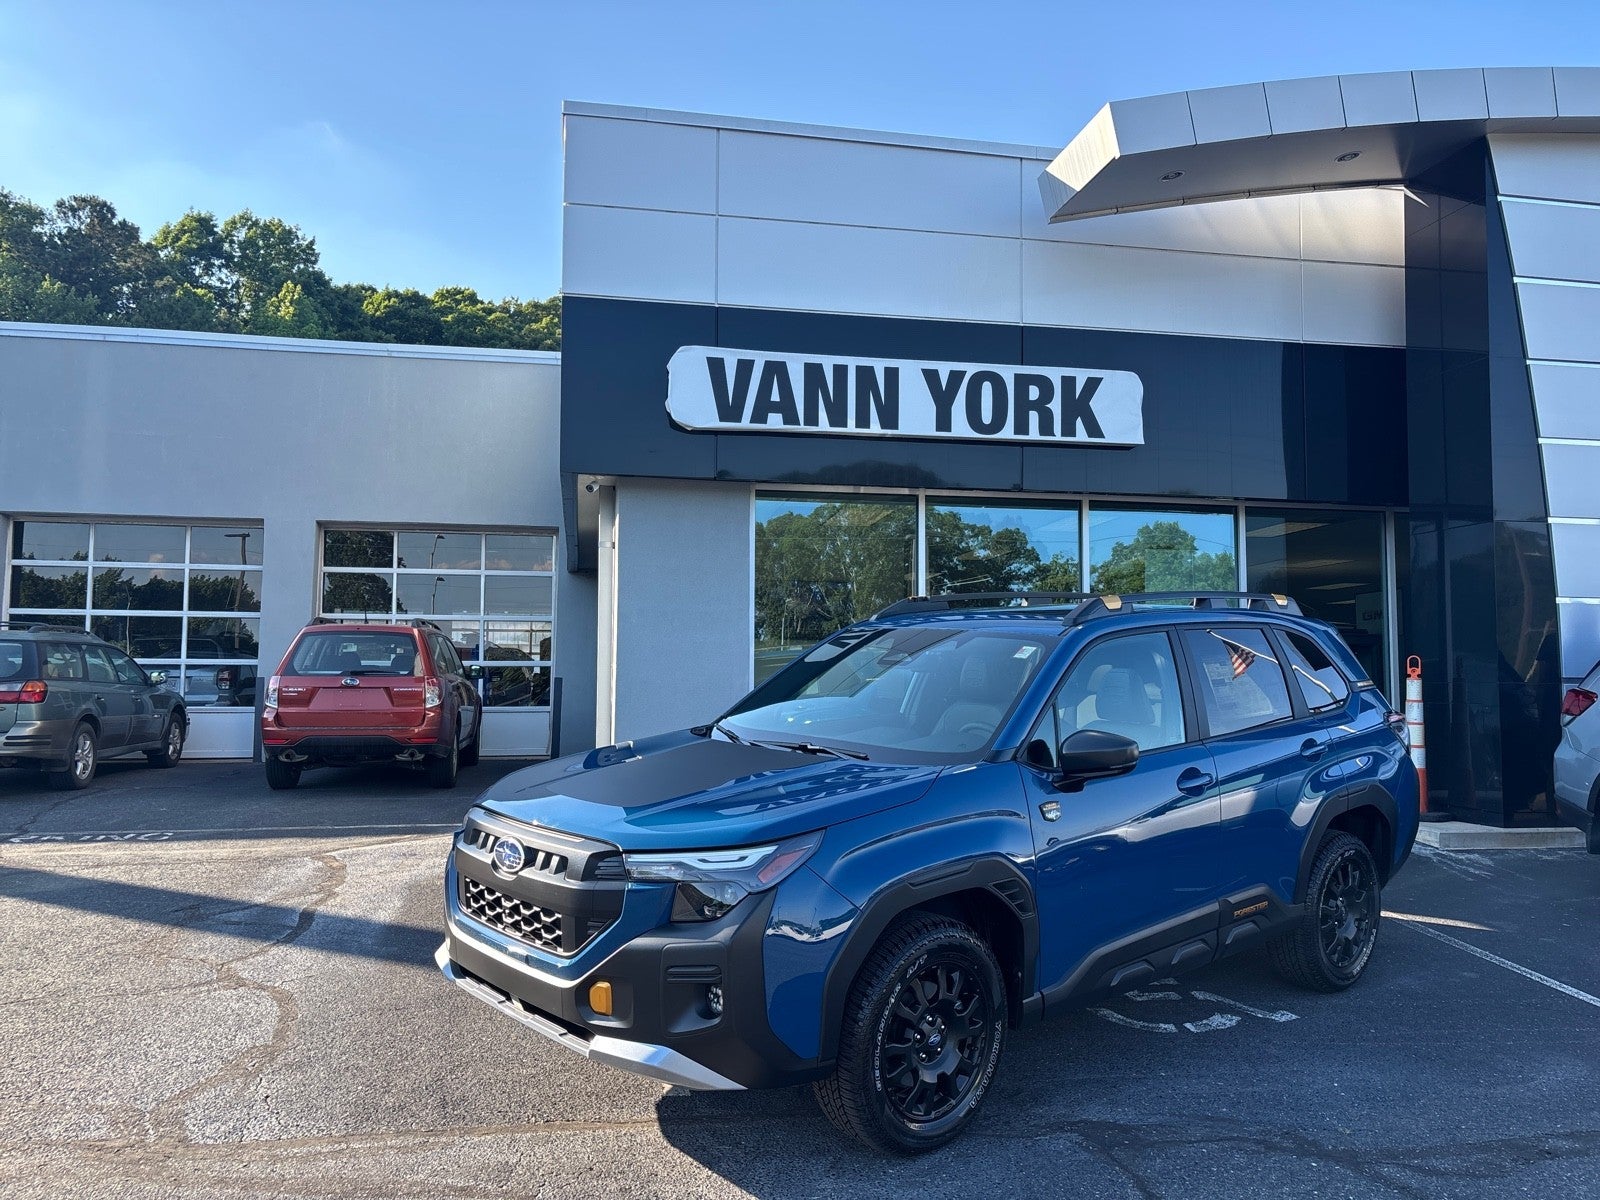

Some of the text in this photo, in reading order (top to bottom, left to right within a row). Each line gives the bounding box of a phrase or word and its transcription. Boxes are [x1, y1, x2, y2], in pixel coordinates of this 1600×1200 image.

[706, 356, 1106, 439] VANN YORK
[969, 1020, 1002, 1109] YOKOHAMA
